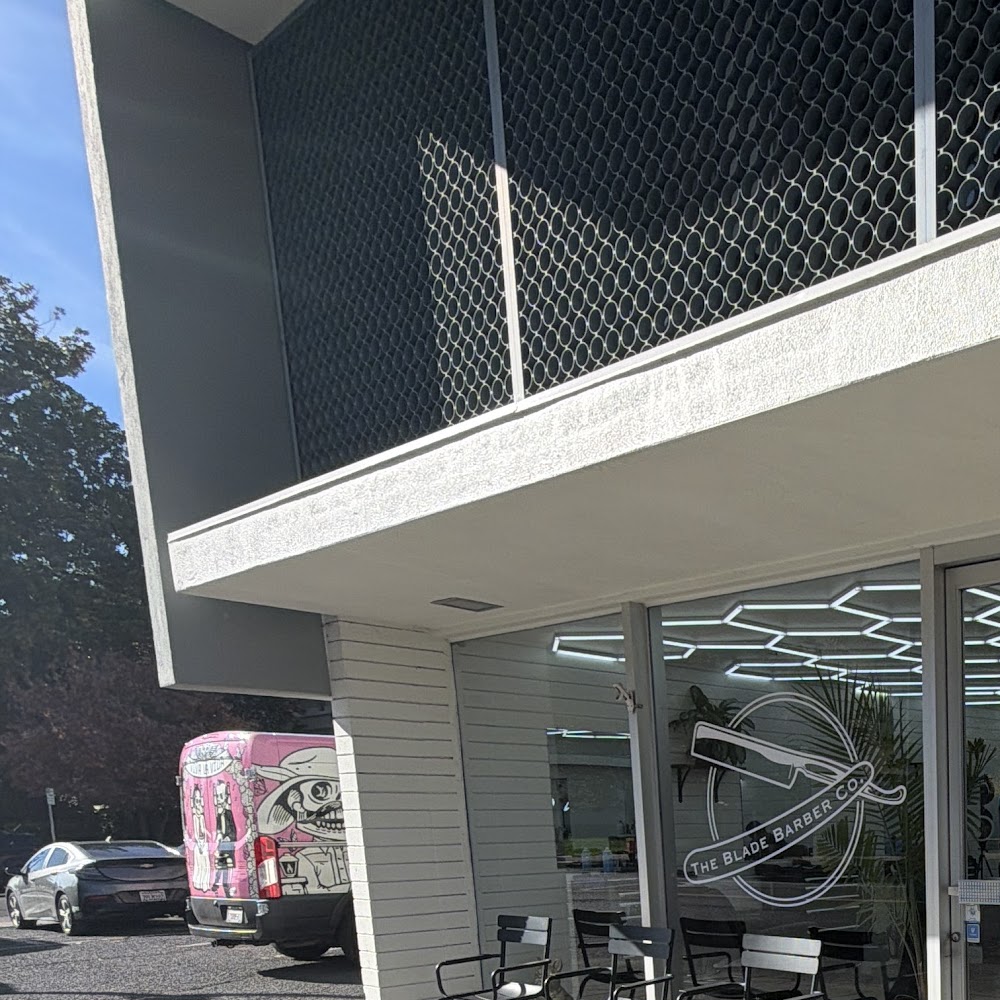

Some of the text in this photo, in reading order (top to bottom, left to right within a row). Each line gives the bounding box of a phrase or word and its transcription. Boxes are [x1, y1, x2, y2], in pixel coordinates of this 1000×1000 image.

[690, 858, 719, 876] THE
[722, 836, 769, 866] BLADE
[772, 799, 833, 843] BARBER
